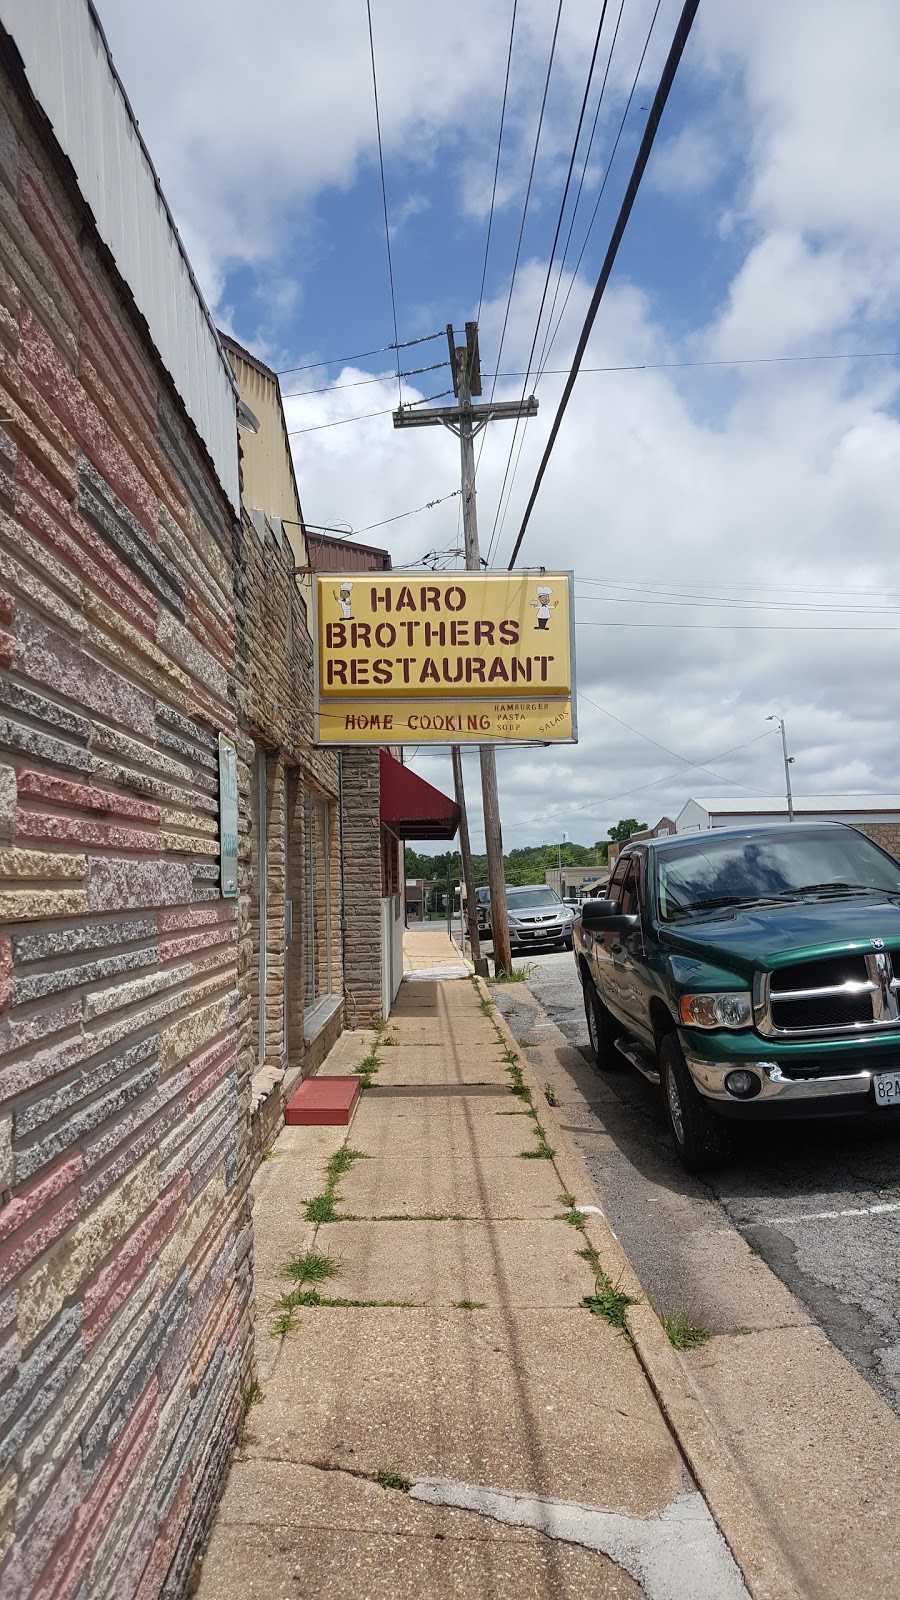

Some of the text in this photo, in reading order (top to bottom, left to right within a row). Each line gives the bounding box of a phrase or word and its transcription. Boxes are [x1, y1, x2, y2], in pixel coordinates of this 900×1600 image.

[370, 586, 467, 613] HARO
[326, 619, 520, 649] BROTHERS
[327, 655, 555, 685] RESTAURANT
[494, 703, 549, 712] HAMBURGER
[497, 713, 526, 721] PASTA
[344, 714, 491, 731] HOME COOKING
[538, 710, 570, 733] SALADS
